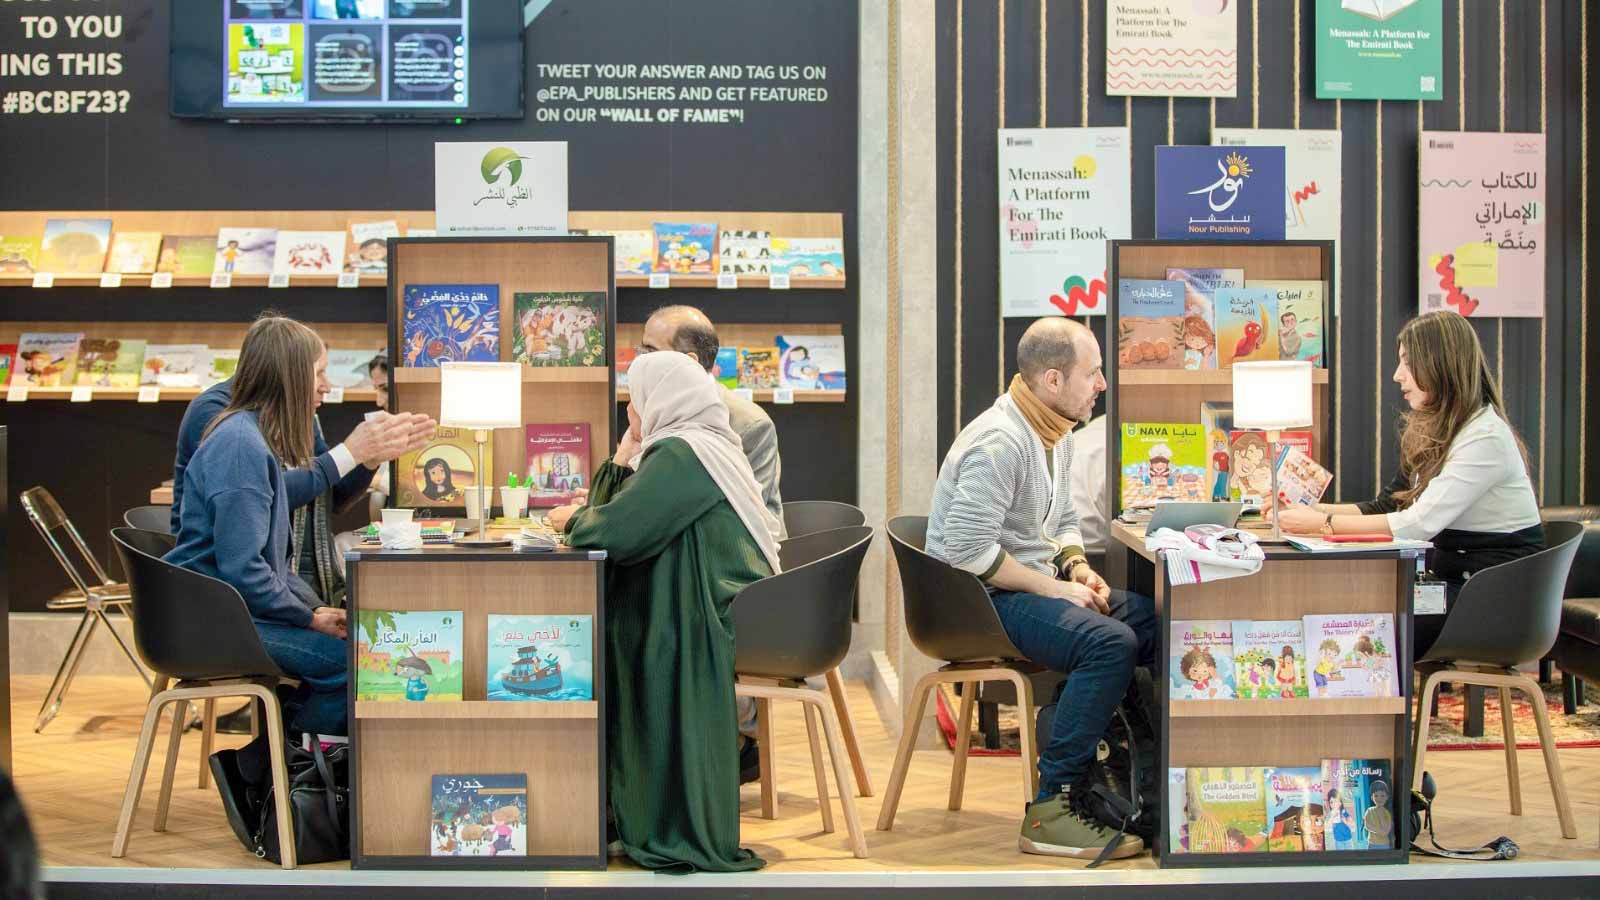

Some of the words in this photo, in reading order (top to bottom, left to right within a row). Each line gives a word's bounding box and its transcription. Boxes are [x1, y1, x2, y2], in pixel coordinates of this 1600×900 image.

[20, 15, 58, 39] TO
[64, 15, 122, 39] YOU
[1116, 18, 1154, 29] Platform
[1158, 19, 1171, 29] For
[1173, 17, 1187, 28] The
[1116, 30, 1149, 40] Emirati
[1152, 30, 1173, 41] Book
[1373, 29, 1380, 38] A
[1381, 29, 1415, 39] Platform
[1417, 31, 1430, 39] For
[1346, 40, 1360, 49] The
[1362, 40, 1391, 49] Emirati
[1394, 41, 1414, 50] Book
[56, 53, 123, 76] THIS
[537, 65, 591, 80] TWEET
[595, 65, 637, 80] YOUR
[640, 65, 706, 80] ANSWER
[709, 65, 743, 80] AND
[746, 65, 775, 80] TAG
[779, 66, 800, 80] US
[803, 66, 826, 80] ON
[537, 86, 676, 102] @EPA_PUBLISHERS
[679, 87, 713, 101] AND
[716, 87, 746, 101] GET
[750, 88, 828, 102] FEATURED
[3, 90, 131, 114] #BCBF23?
[536, 109, 560, 122] ON
[563, 108, 596, 122] OUR
[657, 109, 680, 122] OF
[1009, 167, 1086, 182] Menassah:
[1481, 171, 1537, 193] للكتاب
[1009, 187, 1020, 201] A
[1025, 187, 1091, 201] Platform
[1009, 207, 1032, 222] For
[1039, 207, 1063, 221] The
[1475, 202, 1537, 229] الإماراتي
[1010, 228, 1066, 242] Emirati
[1071, 227, 1108, 241] Book
[1189, 225, 1208, 234] Nour
[1210, 225, 1250, 235] Publishing
[1140, 427, 1168, 436] NAYA
[443, 778, 484, 794] جوري
